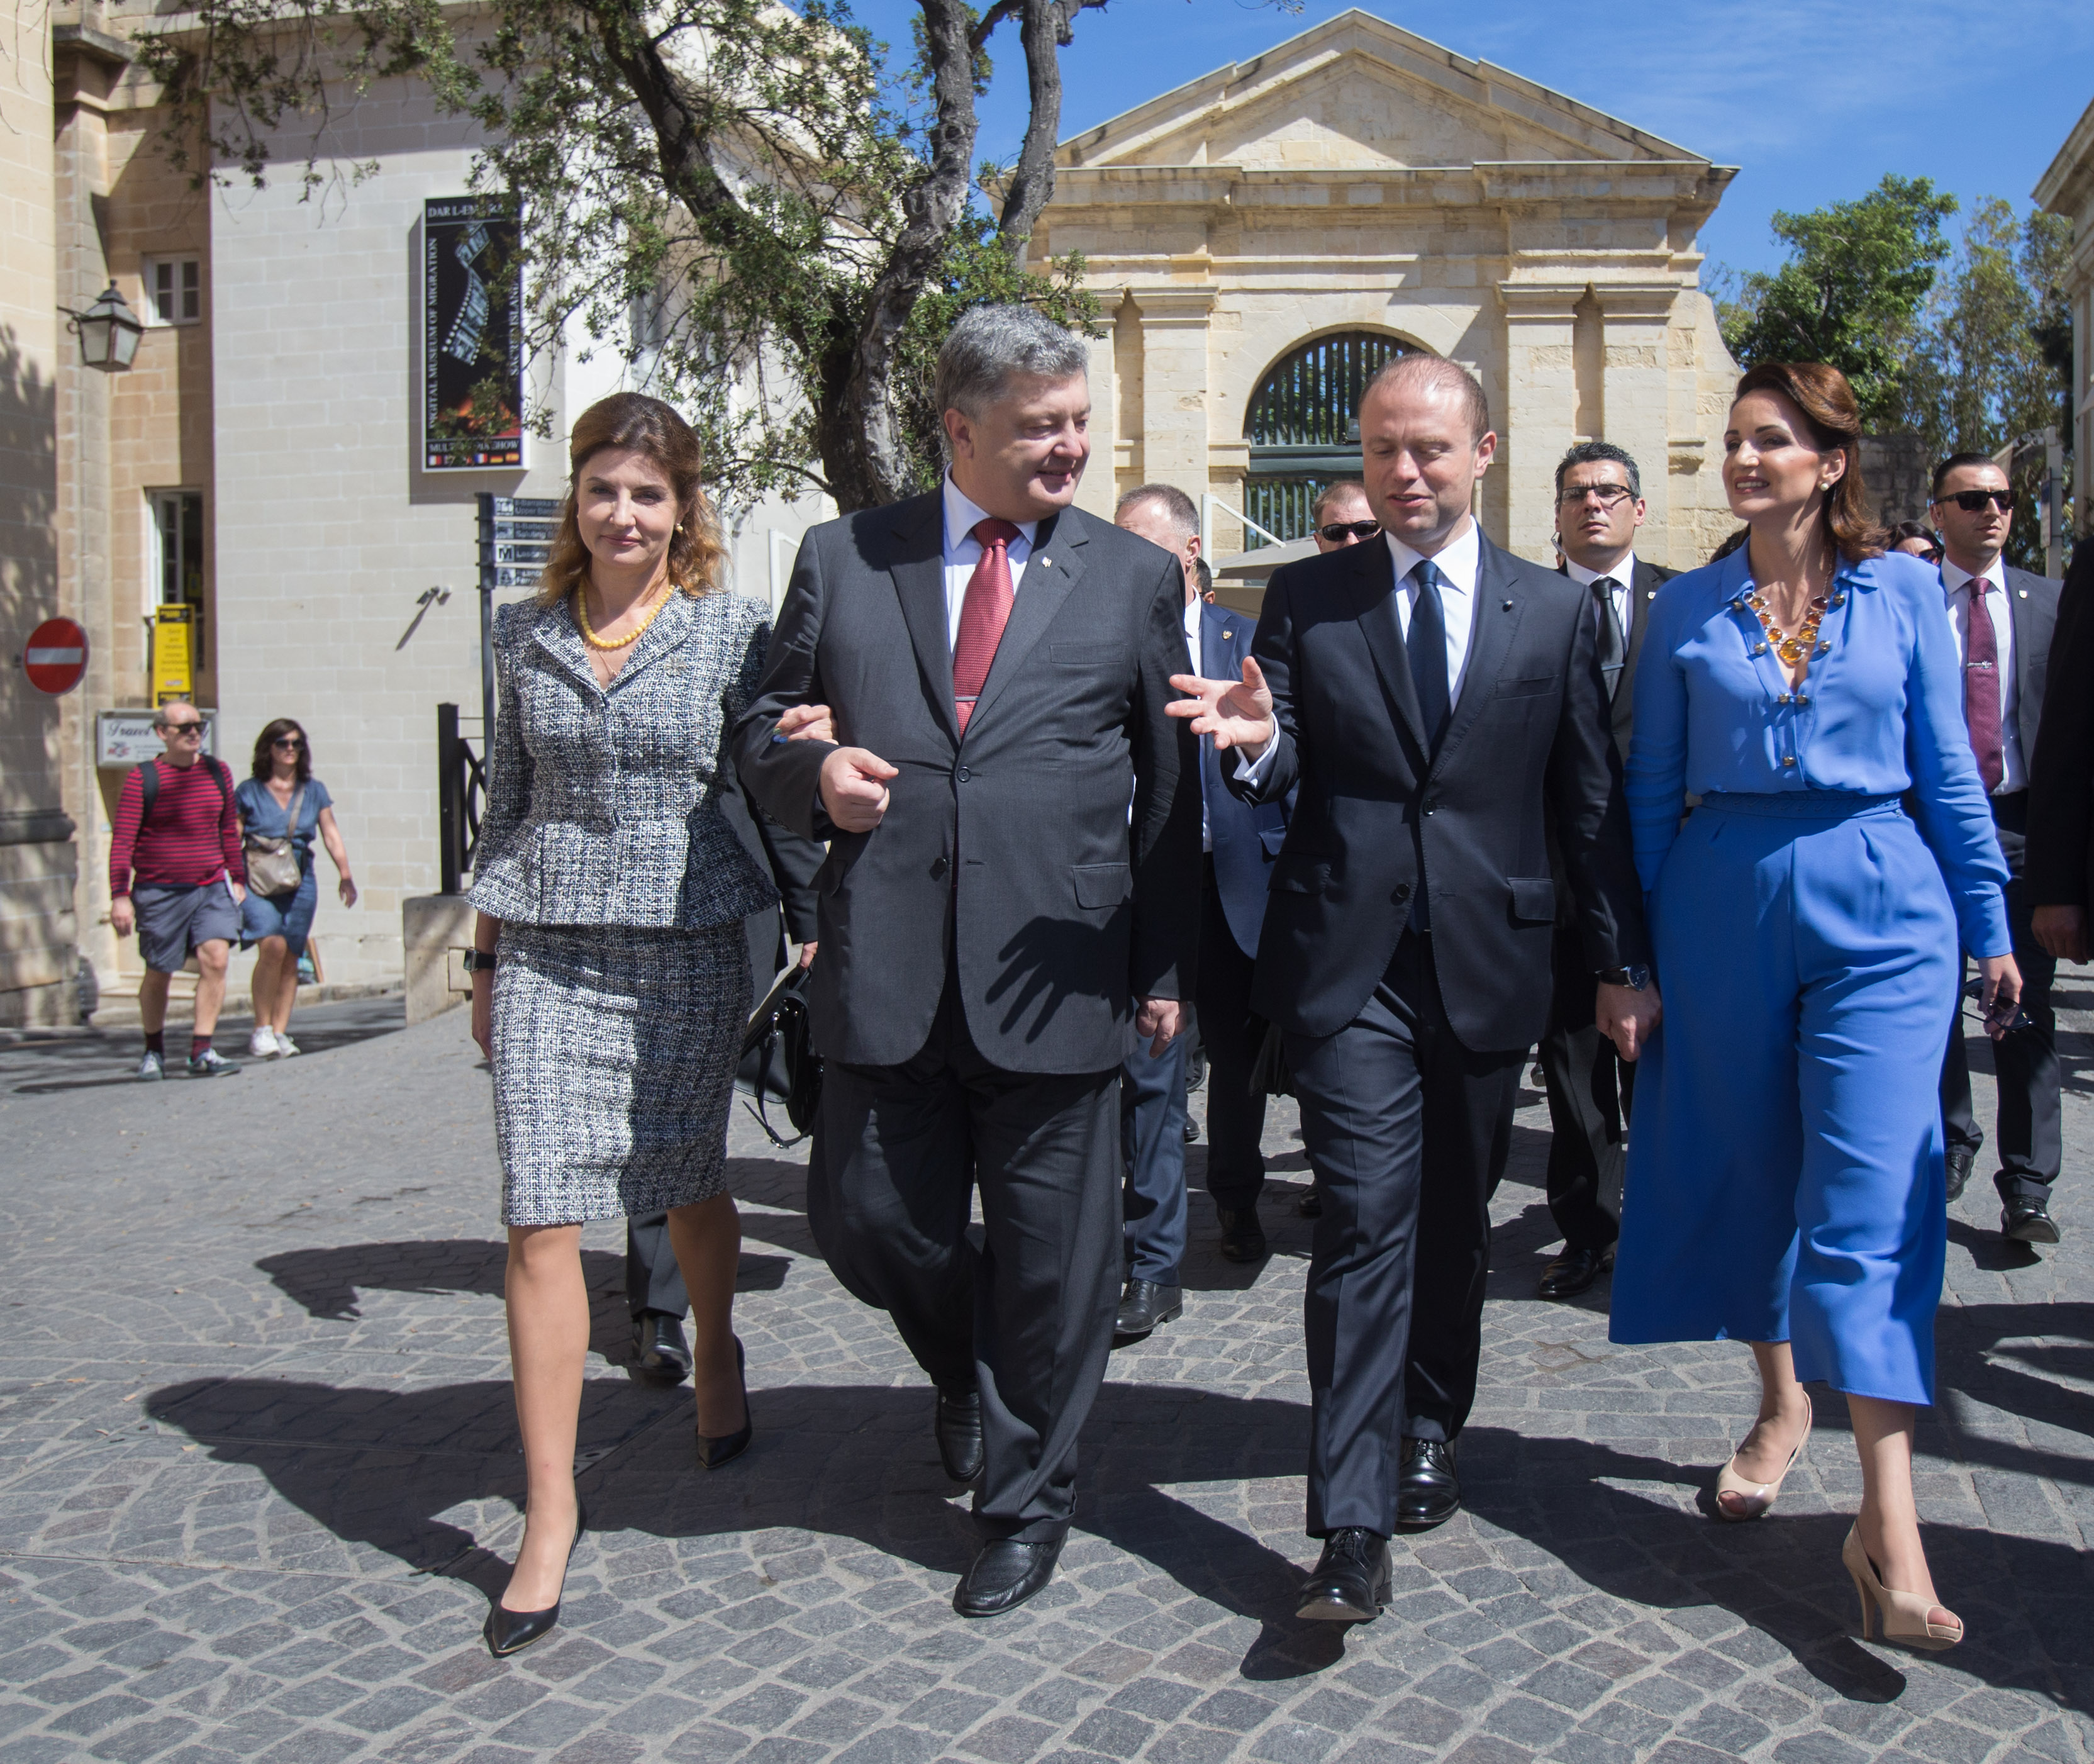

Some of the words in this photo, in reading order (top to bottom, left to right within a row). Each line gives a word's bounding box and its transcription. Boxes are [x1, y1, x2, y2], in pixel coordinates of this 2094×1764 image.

[427, 205, 451, 218] DAR
[428, 238, 438, 306] MIGRATION
[428, 307, 438, 325] OF
[428, 325, 438, 378] MUSEUM
